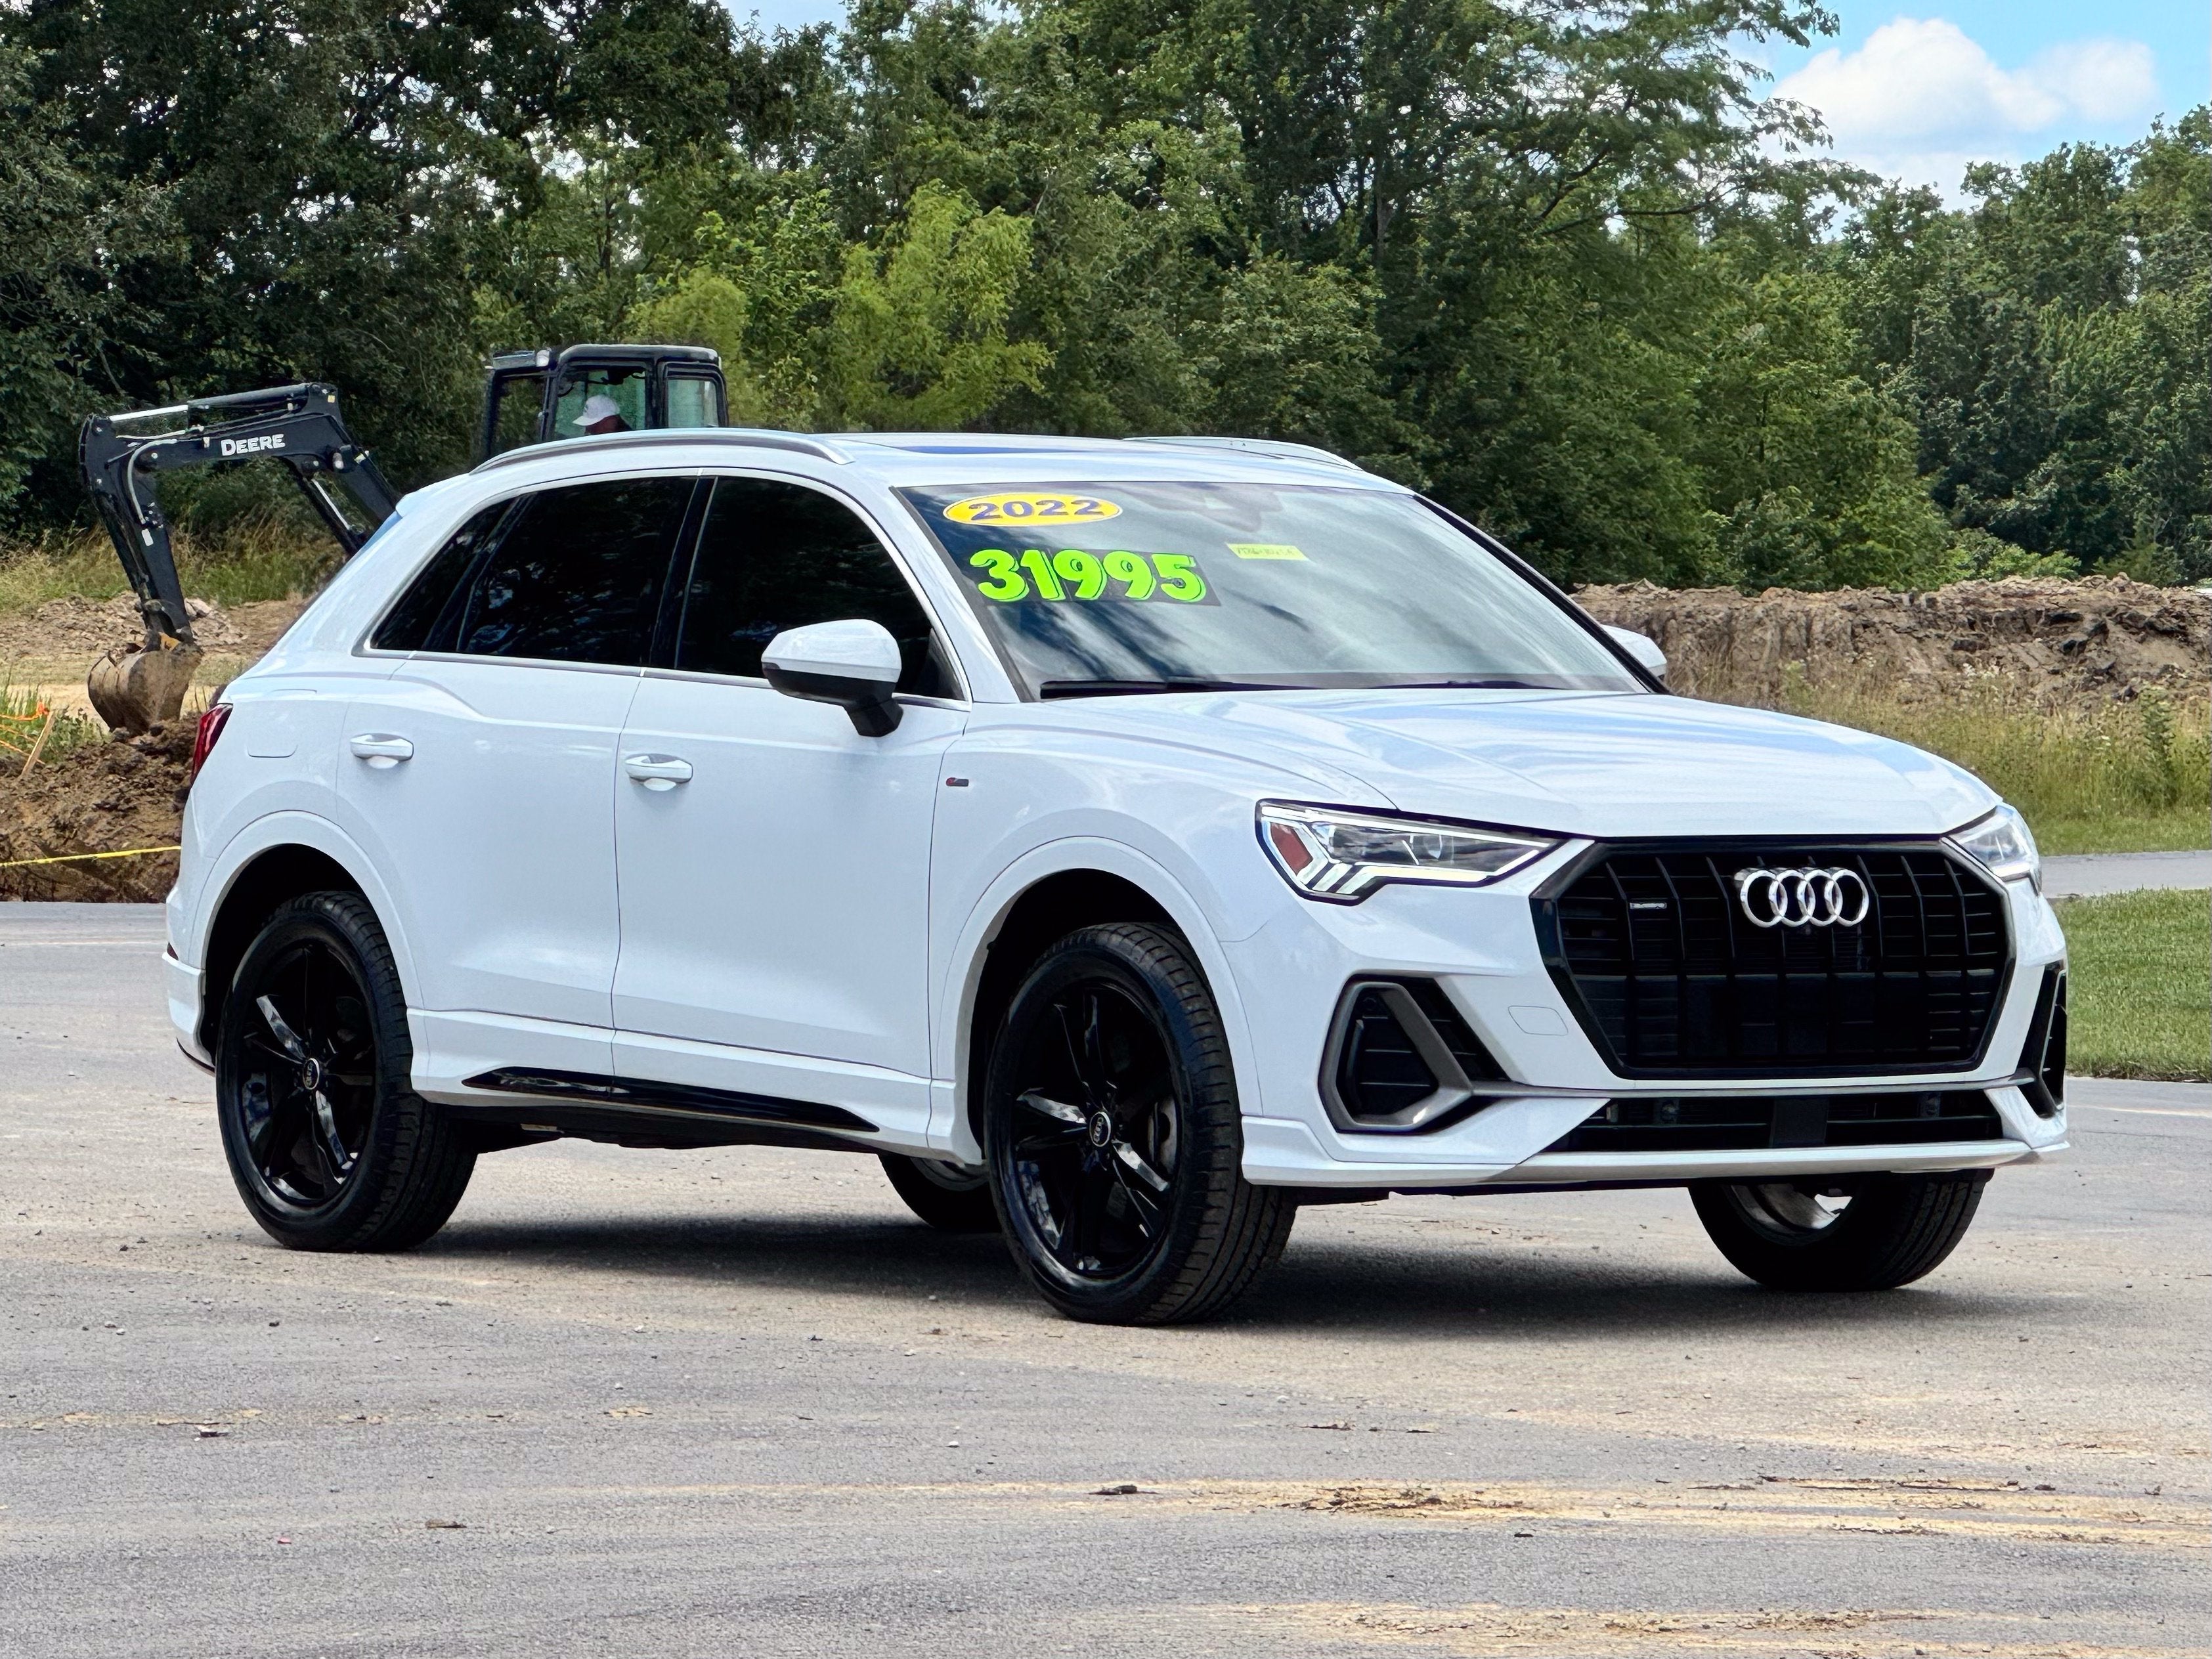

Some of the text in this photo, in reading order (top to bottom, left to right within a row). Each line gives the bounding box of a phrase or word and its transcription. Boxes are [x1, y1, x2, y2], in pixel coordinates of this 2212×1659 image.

[221, 433, 286, 456] DEERE
[968, 500, 1105, 521] 2022
[969, 549, 1207, 602] 31995
